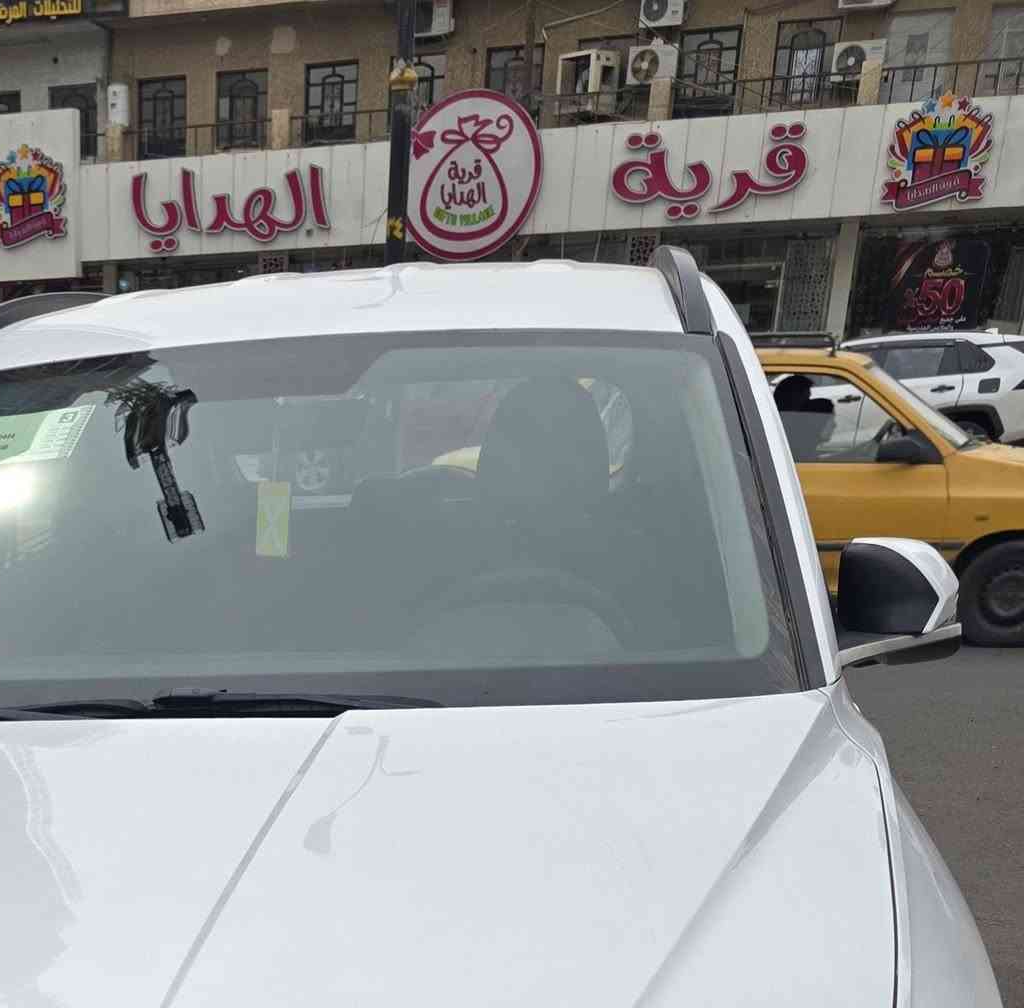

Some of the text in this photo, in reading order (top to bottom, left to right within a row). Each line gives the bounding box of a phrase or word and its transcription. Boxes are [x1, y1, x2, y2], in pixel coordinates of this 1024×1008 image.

[130, 122, 810, 253] قرية الهدايا
[447, 159, 483, 184] قرية
